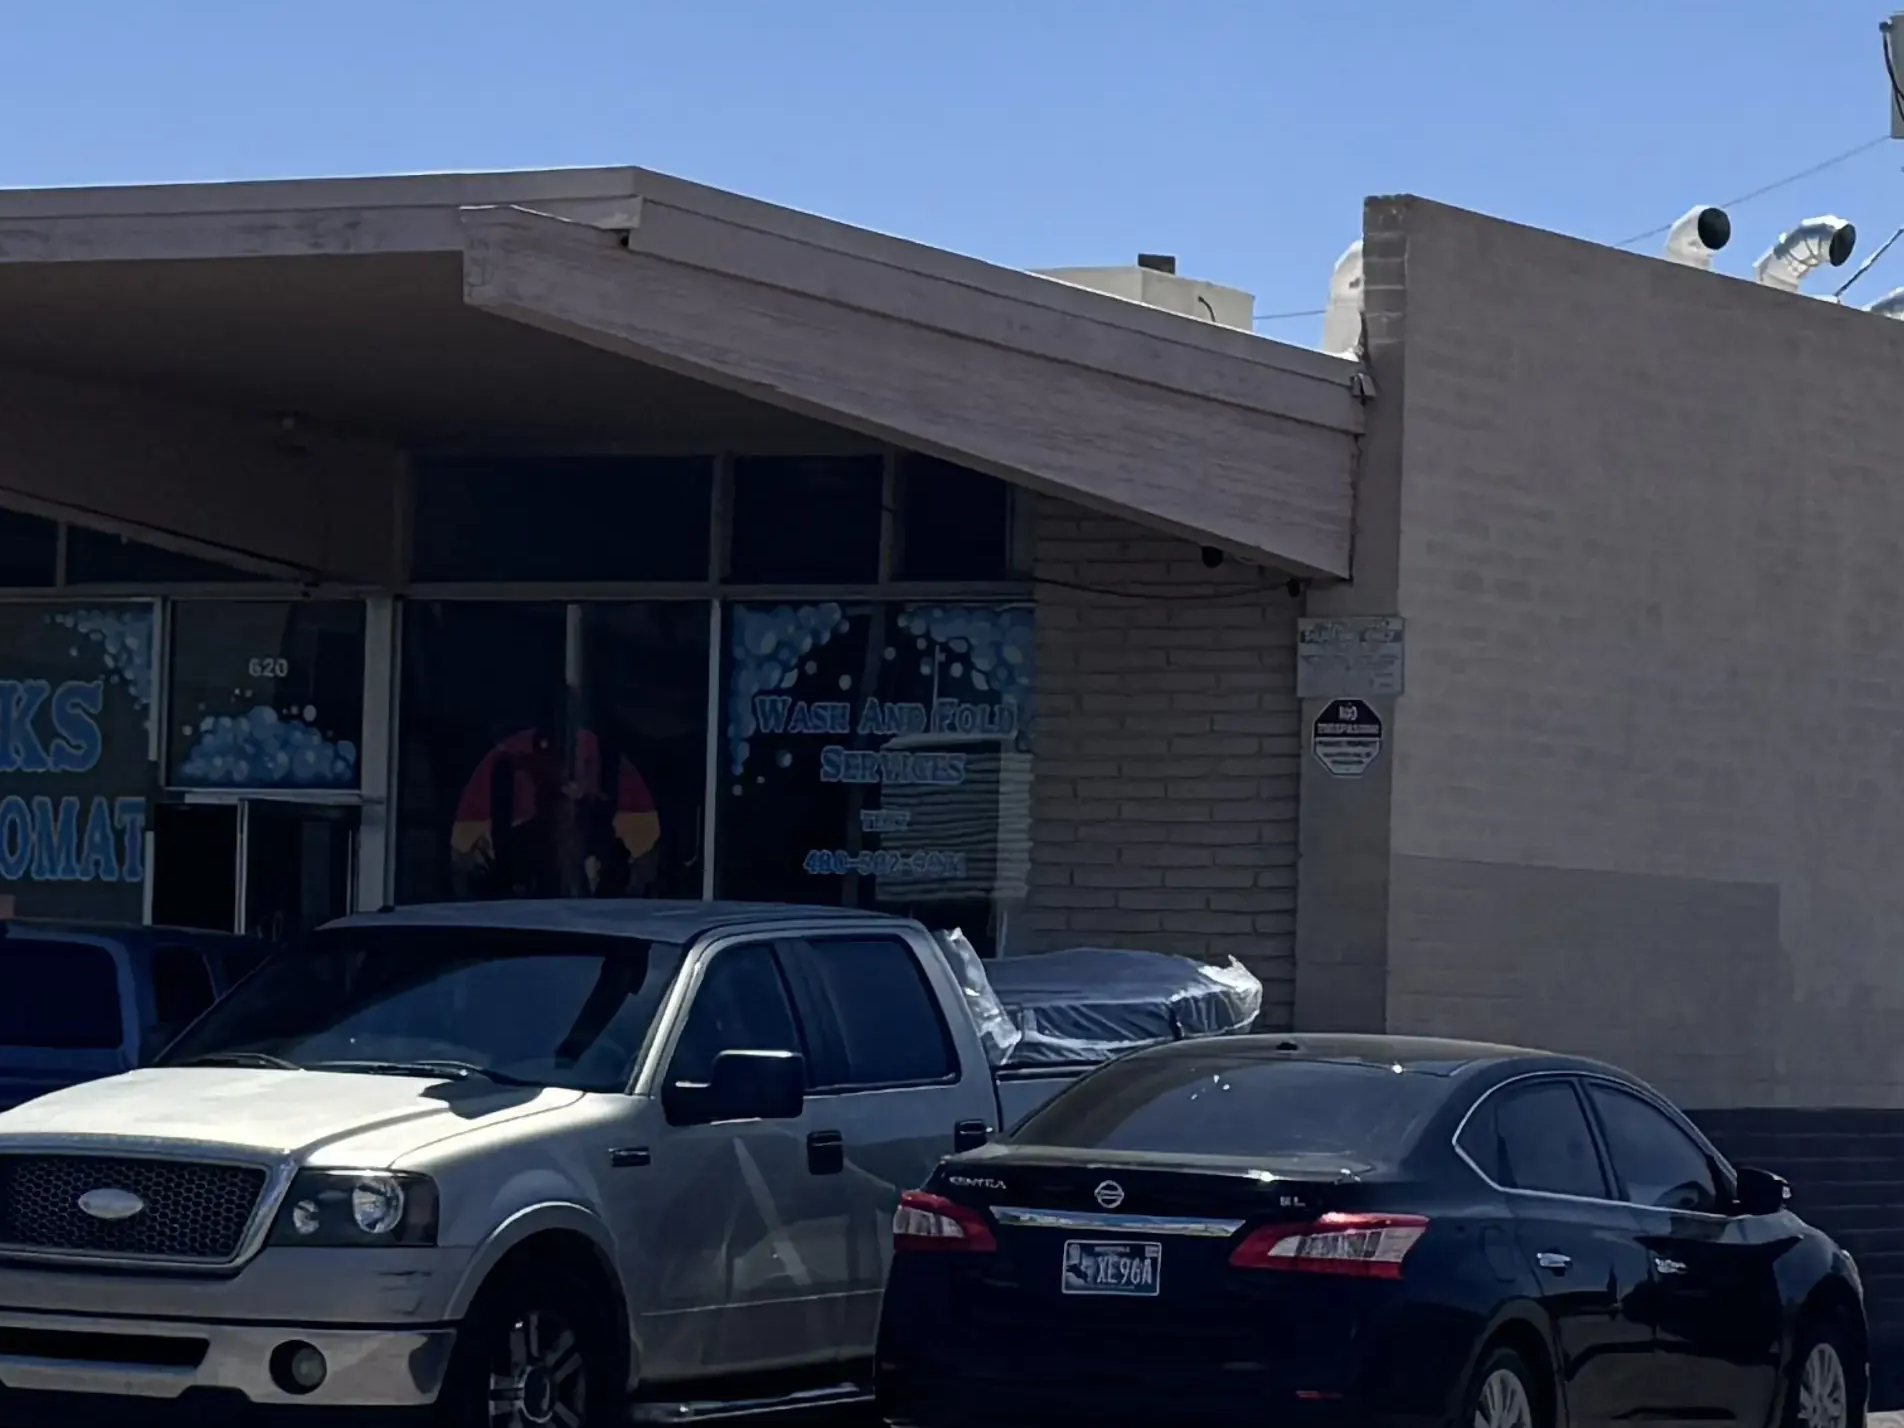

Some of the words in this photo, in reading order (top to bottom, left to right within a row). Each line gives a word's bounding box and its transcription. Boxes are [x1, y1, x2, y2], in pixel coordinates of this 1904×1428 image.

[248, 657, 289, 678] 620
[754, 695, 851, 734] WASH
[857, 696, 927, 734] AND
[935, 697, 1018, 734] FOLD
[820, 745, 968, 785] SERVICES
